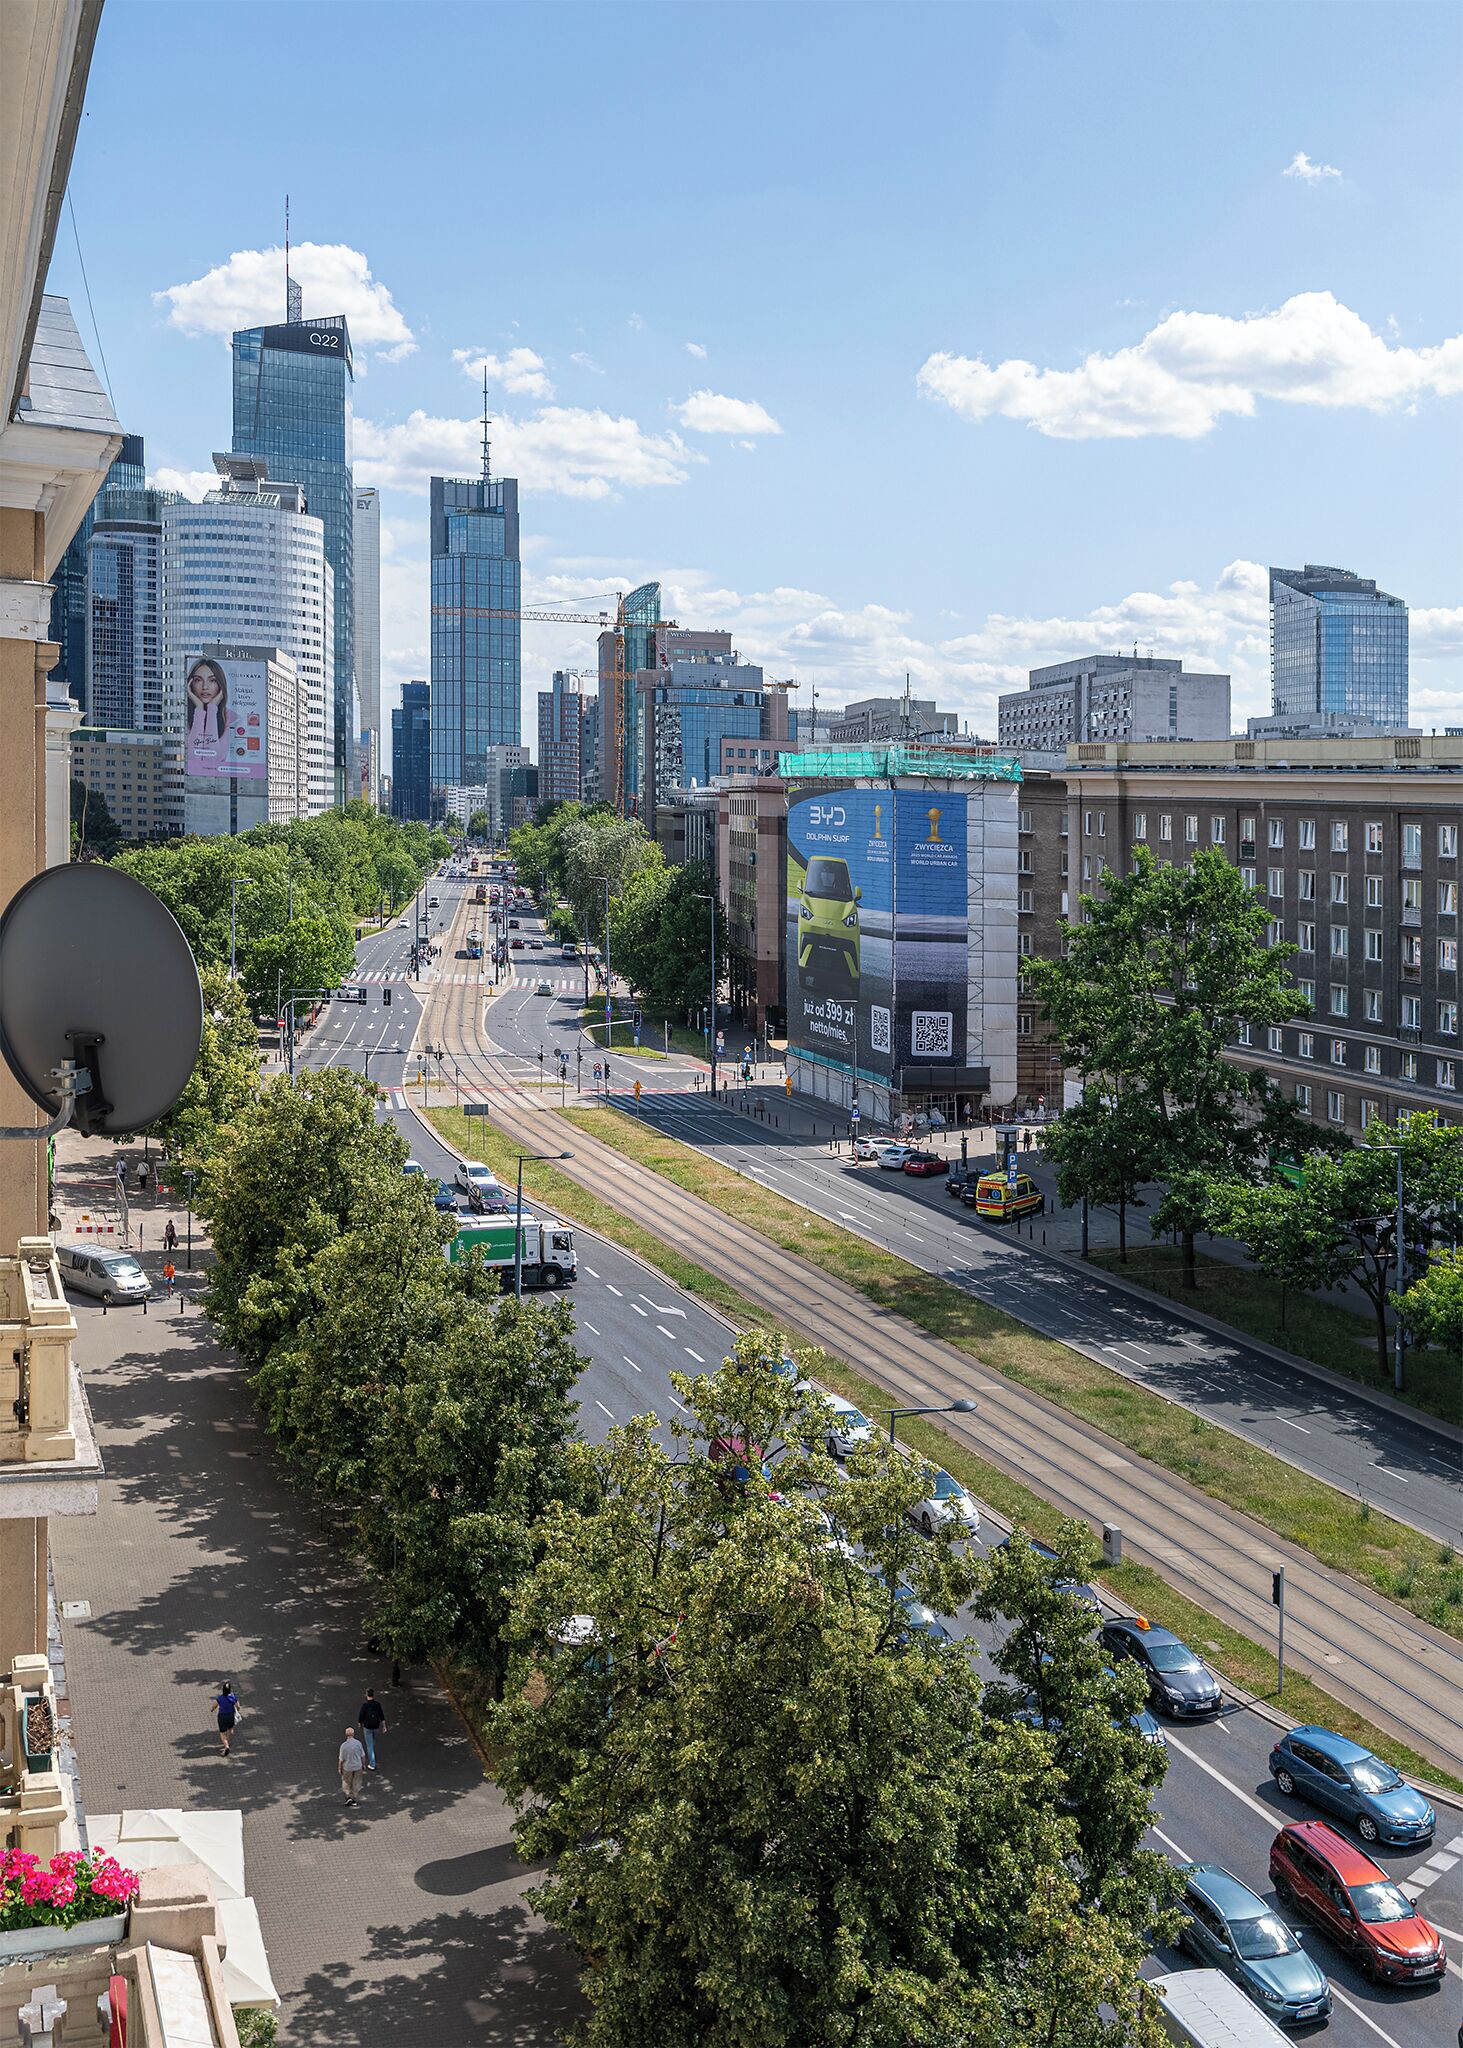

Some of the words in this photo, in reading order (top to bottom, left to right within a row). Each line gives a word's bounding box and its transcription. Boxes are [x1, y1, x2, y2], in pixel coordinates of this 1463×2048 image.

[309, 332, 339, 349] Q22
[356, 500, 372, 511] EY
[806, 832, 832, 842] DOLPHIN
[832, 834, 850, 843] SURF
[914, 843, 954, 853] ZWYCIĘZCA
[803, 999, 814, 1016] już
[815, 1005, 825, 1016] od
[826, 1002, 843, 1021] 399
[844, 1007, 854, 1026] zł
[853, 1109, 859, 1118] P
[1010, 1155, 1016, 1164] P
[1010, 1171, 1016, 1180] P
